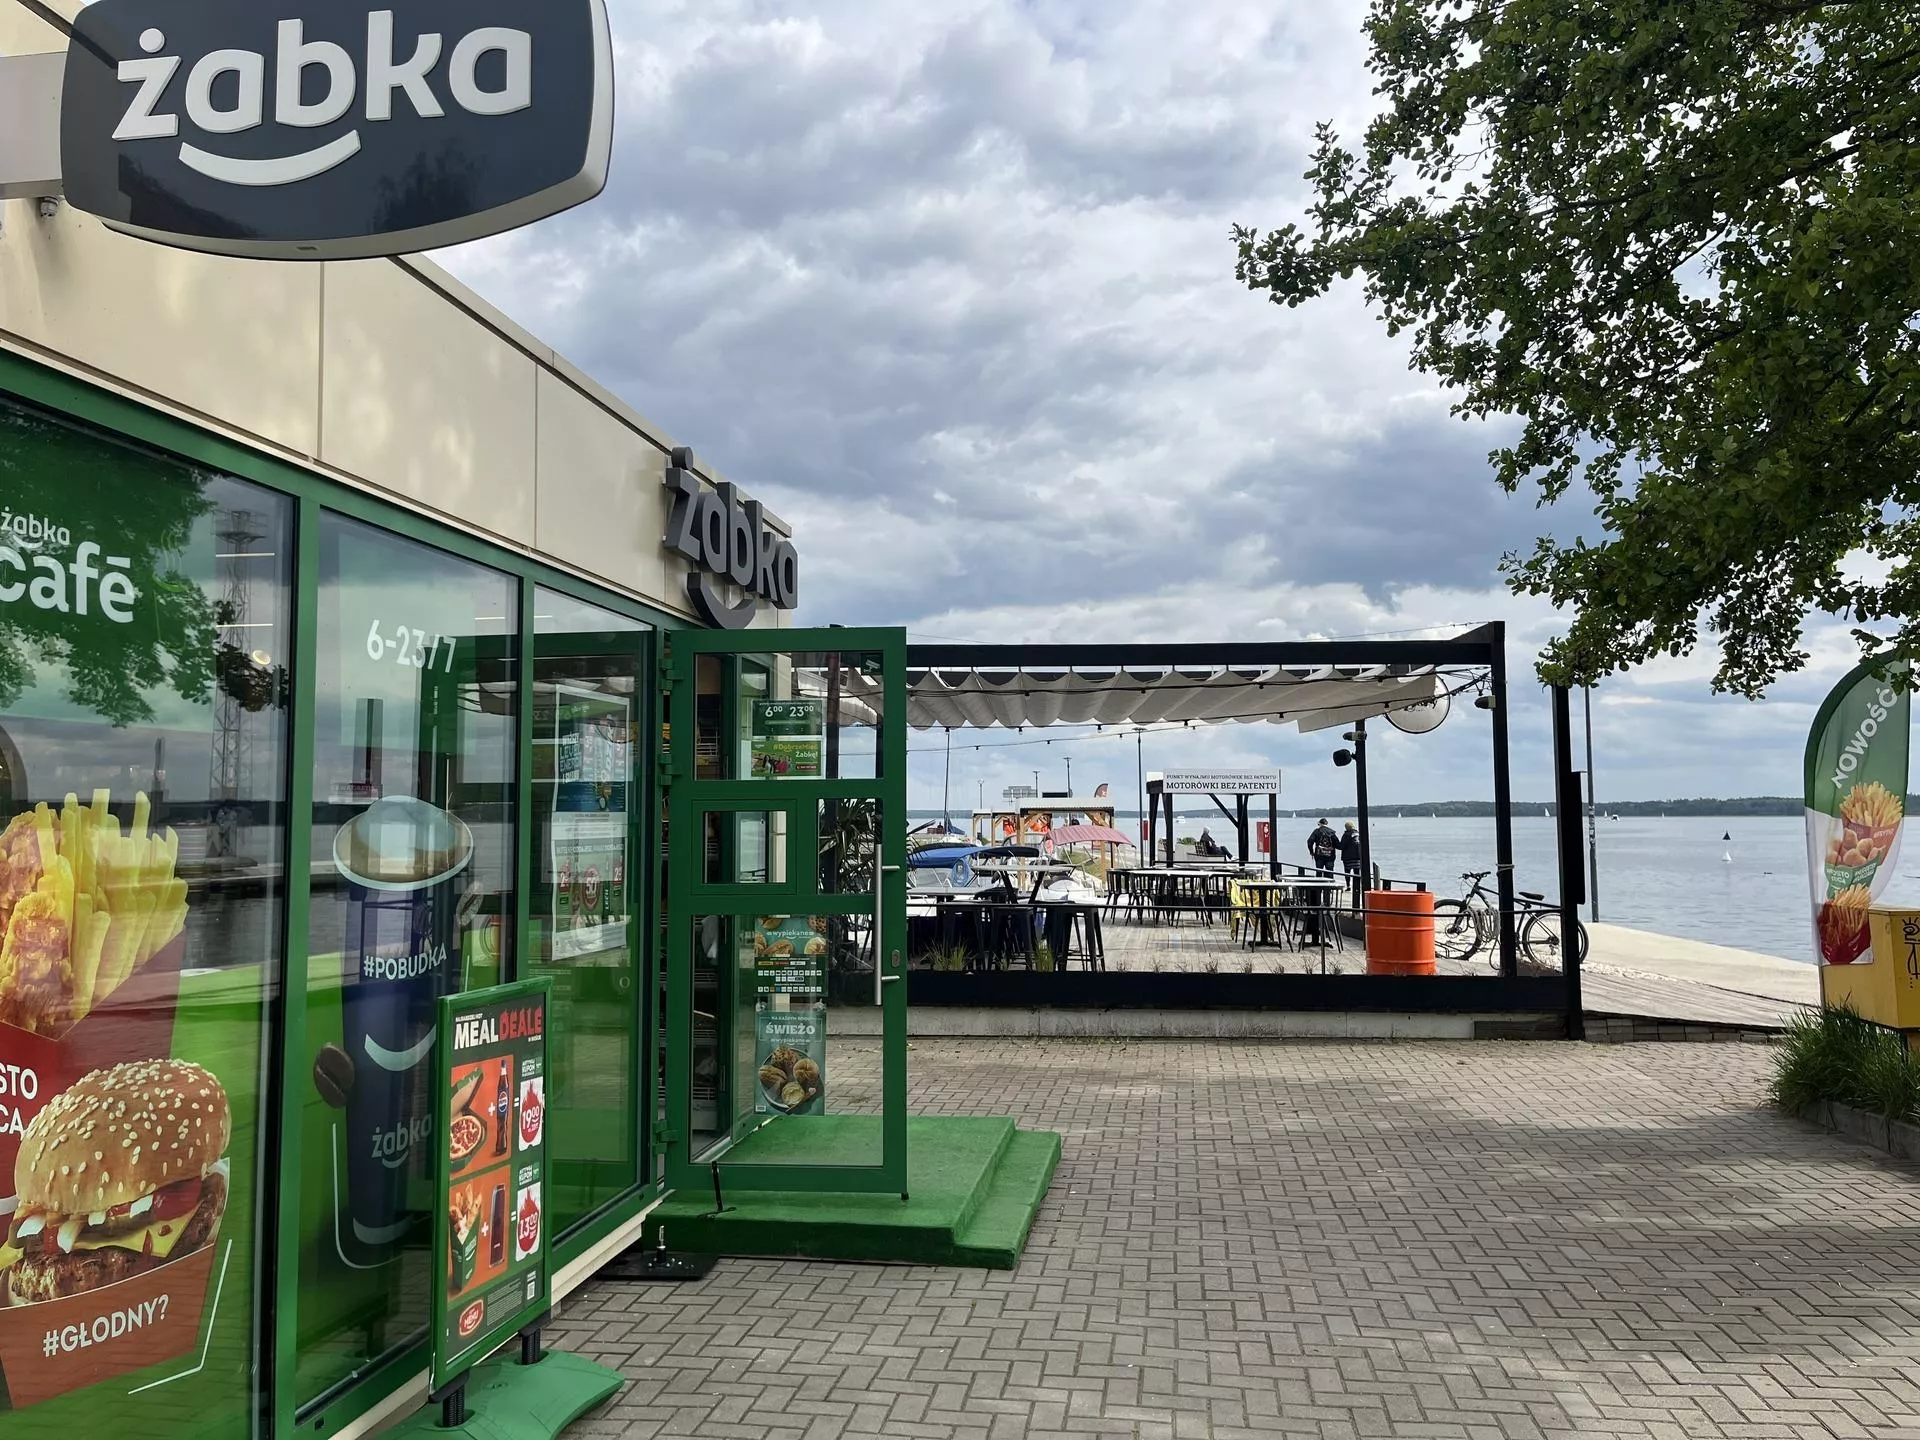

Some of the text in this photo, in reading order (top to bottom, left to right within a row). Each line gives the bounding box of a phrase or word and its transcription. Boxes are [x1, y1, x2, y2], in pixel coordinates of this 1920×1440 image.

[111, 9, 533, 141] żabka
[0, 506, 70, 545] żabka
[664, 446, 798, 610] żabka
[366, 619, 457, 673] 6-23/7
[1831, 686, 1898, 789] NOWOŚĆ
[1166, 781, 1277, 790] MOTORÓWKI BEZ PATENTU
[364, 942, 447, 980] #POBUDKA
[454, 1005, 542, 1050] MEAL DEALE
[765, 1021, 815, 1035] ŚWIEŻO
[371, 1113, 432, 1158] żabka
[43, 1293, 169, 1357] #GŁODNY?
